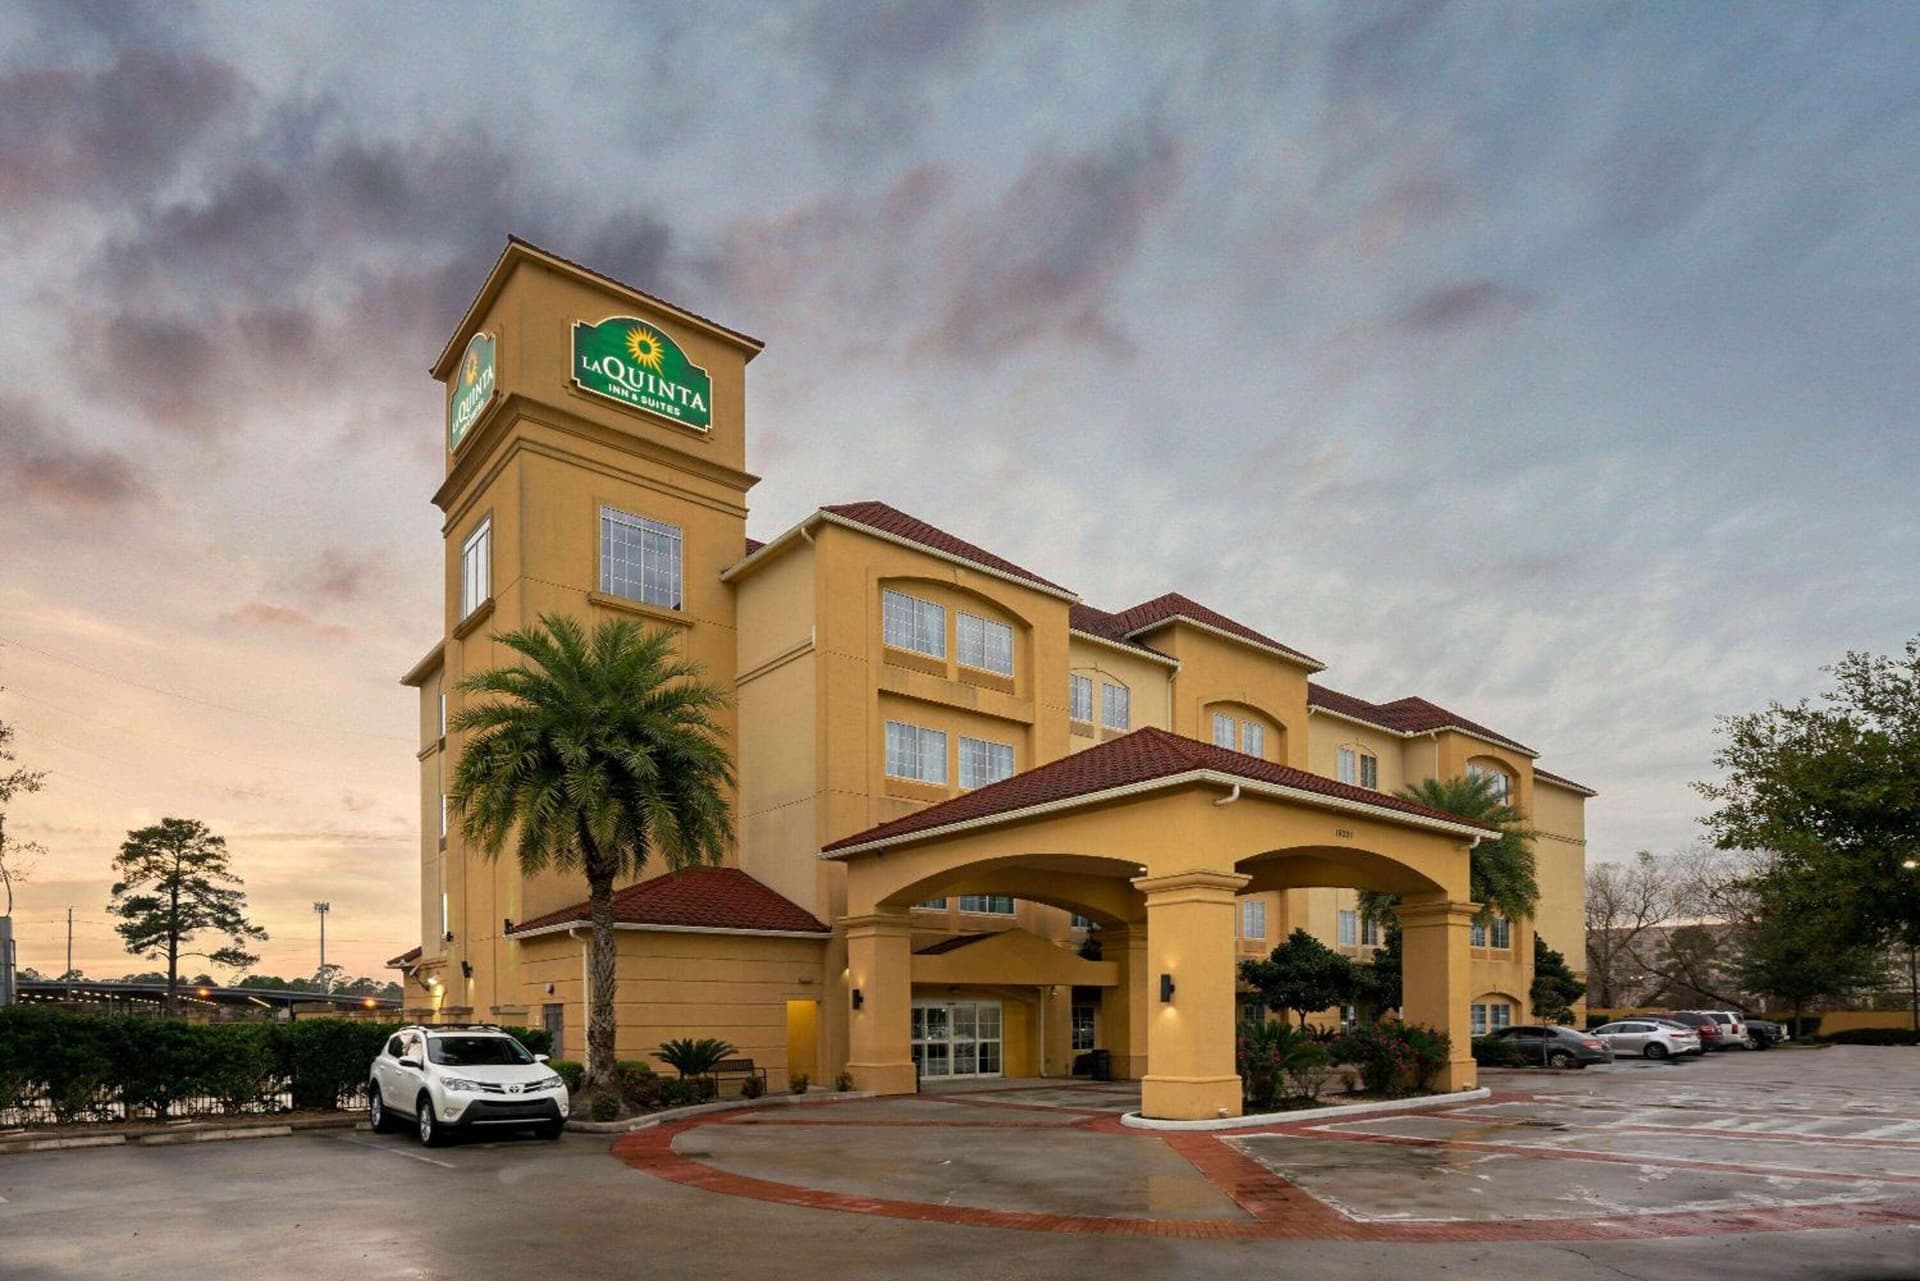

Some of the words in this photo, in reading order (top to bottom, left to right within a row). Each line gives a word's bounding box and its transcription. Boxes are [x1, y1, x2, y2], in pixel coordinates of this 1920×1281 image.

[602, 356, 707, 412] QUINTA
[608, 383, 629, 398] INN
[640, 395, 681, 417] SUITES
